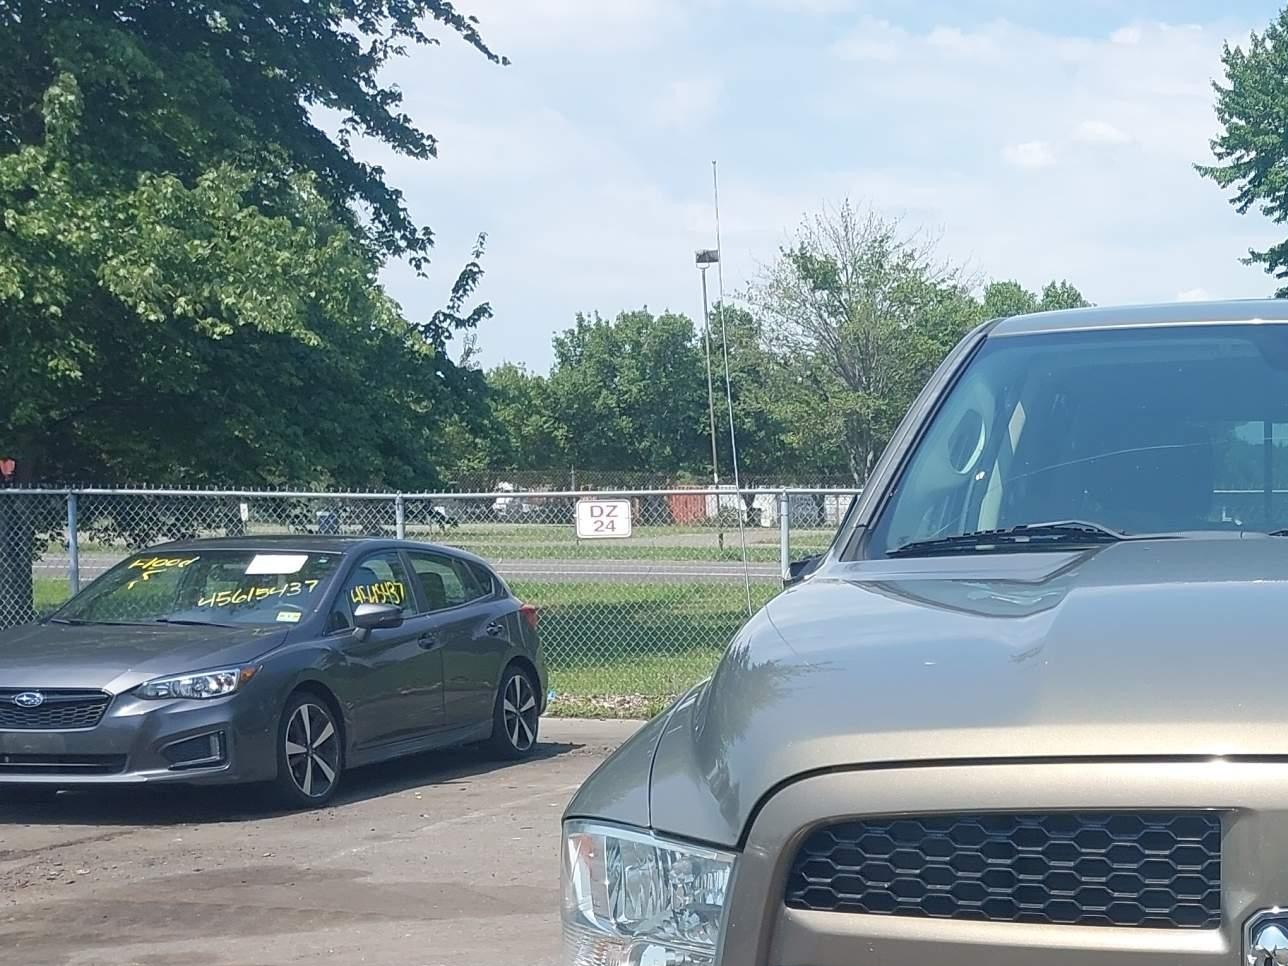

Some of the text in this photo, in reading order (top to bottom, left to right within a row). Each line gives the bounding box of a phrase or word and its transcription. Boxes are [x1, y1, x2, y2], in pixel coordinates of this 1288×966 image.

[590, 504, 618, 518] DZ
[593, 519, 617, 532] 24
[198, 580, 319, 608] 45615437
